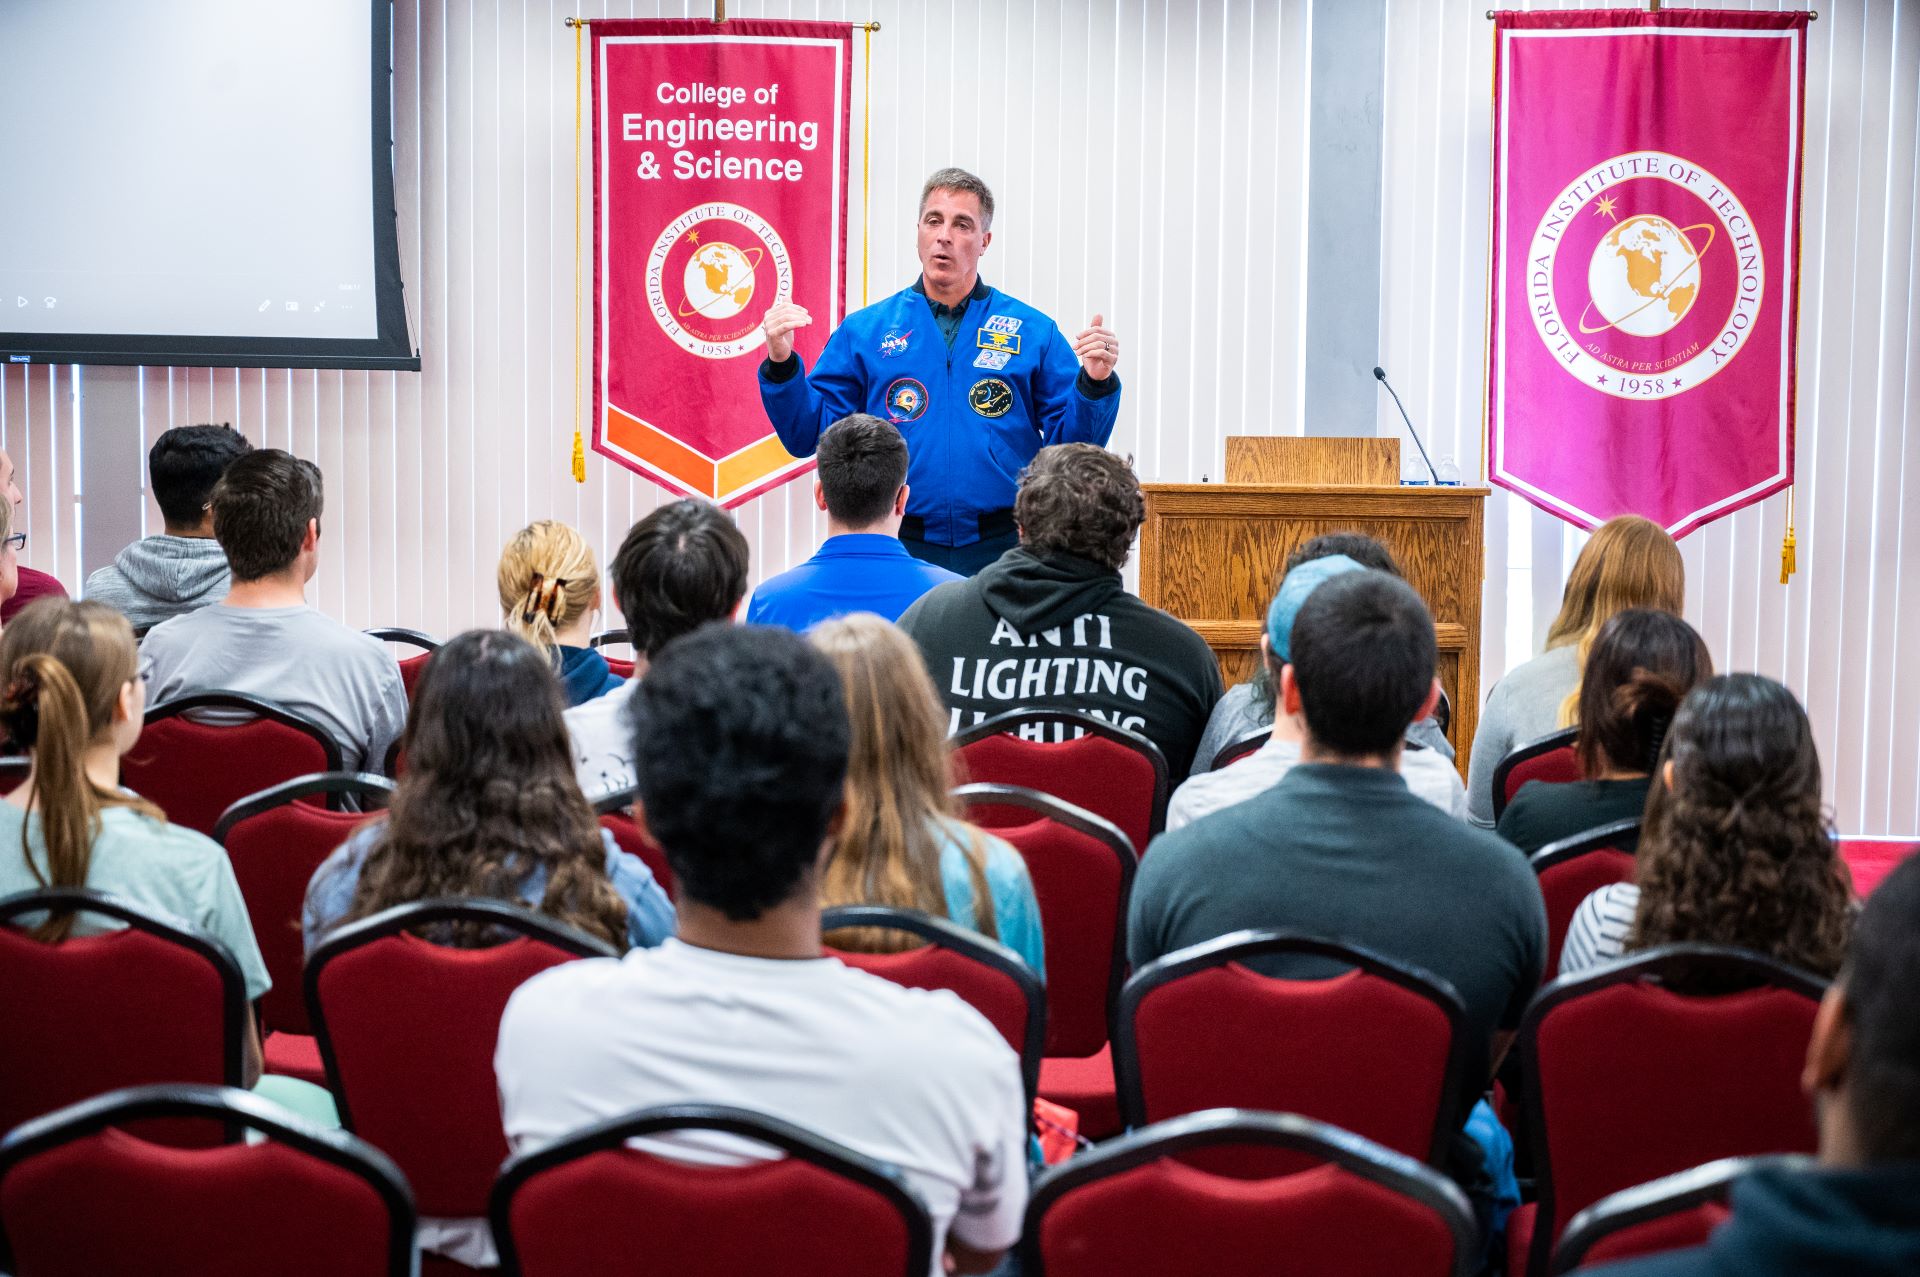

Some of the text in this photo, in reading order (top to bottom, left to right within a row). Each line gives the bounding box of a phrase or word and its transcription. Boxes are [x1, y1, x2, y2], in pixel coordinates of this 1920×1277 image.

[656, 82, 778, 108] College of
[622, 112, 819, 151] Engineering
[637, 150, 803, 182] & Science
[650, 206, 790, 336] FLORIDA INSTITUTE OF TECHNOL
[1533, 157, 1758, 365] FLORIDA INSTITUTE OF TECHNOLOGY
[682, 321, 690, 330] AD
[690, 328, 708, 340] ASTRA
[723, 322, 755, 340] SCIENTIAM
[881, 338, 908, 349] NASA
[701, 344, 731, 356] 1958
[1585, 341, 1700, 371] AD ASTRA PER SCIENTIAM
[1619, 377, 1665, 395] 1958
[990, 613, 1112, 649] ANTI
[950, 657, 1148, 701] LIGHTING
